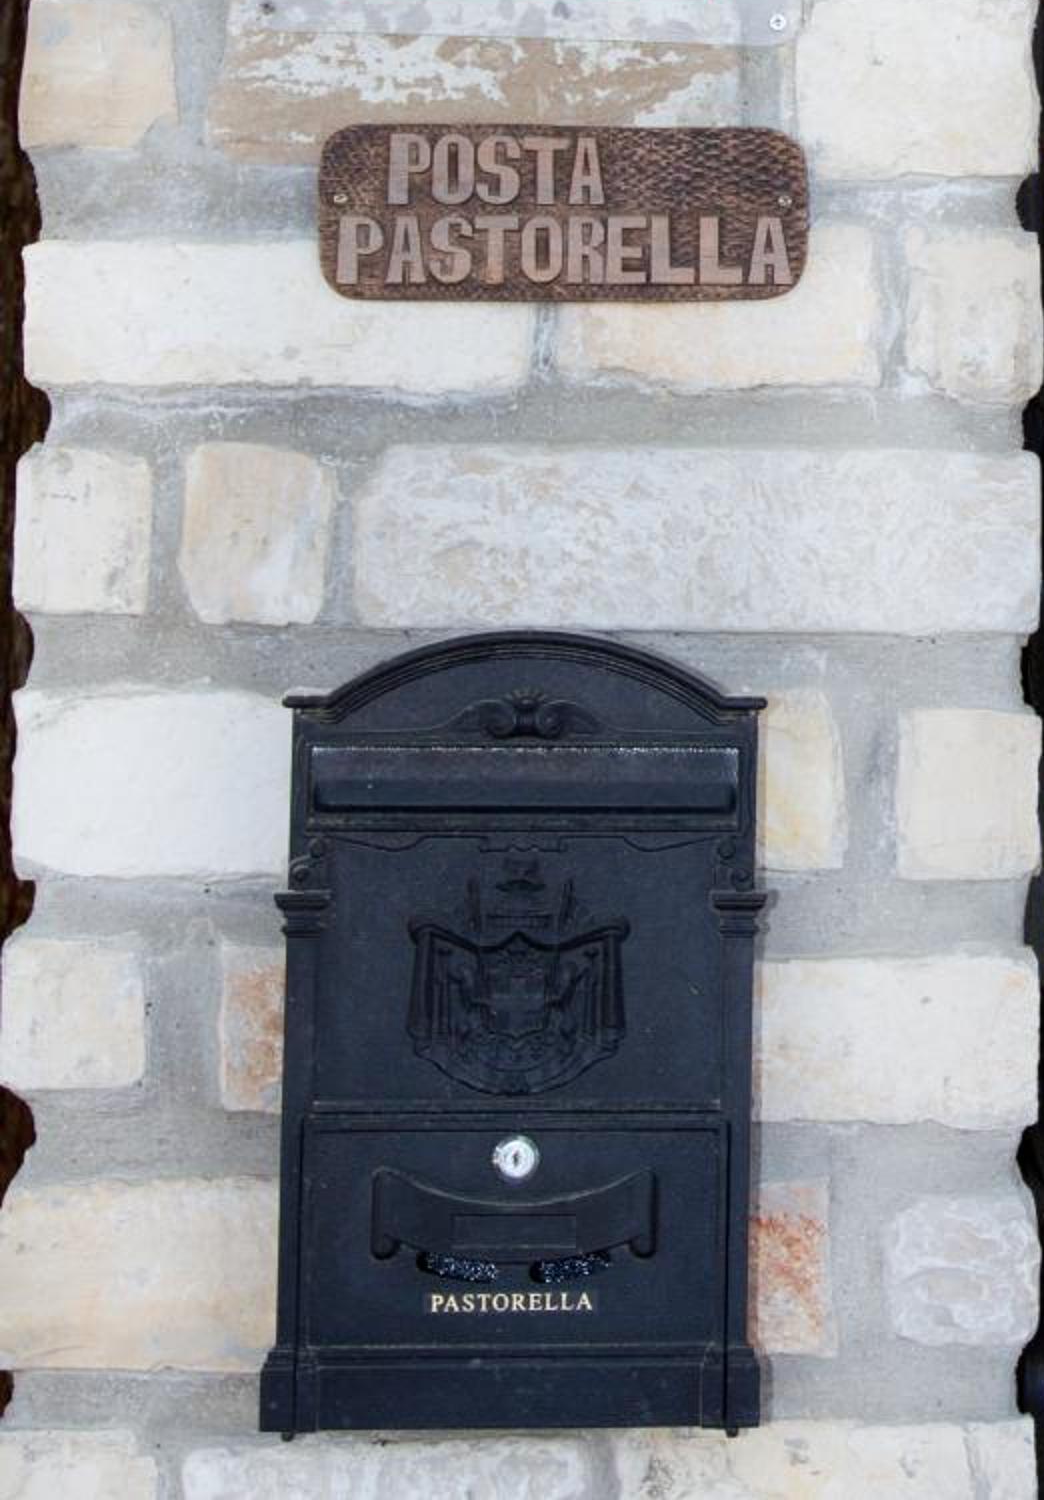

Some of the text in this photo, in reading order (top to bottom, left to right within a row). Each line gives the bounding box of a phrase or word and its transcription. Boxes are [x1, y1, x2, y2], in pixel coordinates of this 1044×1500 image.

[387, 132, 606, 206] POSTA
[335, 214, 793, 286] PASTORELLA
[430, 1292, 594, 1313] PASTORELLA
